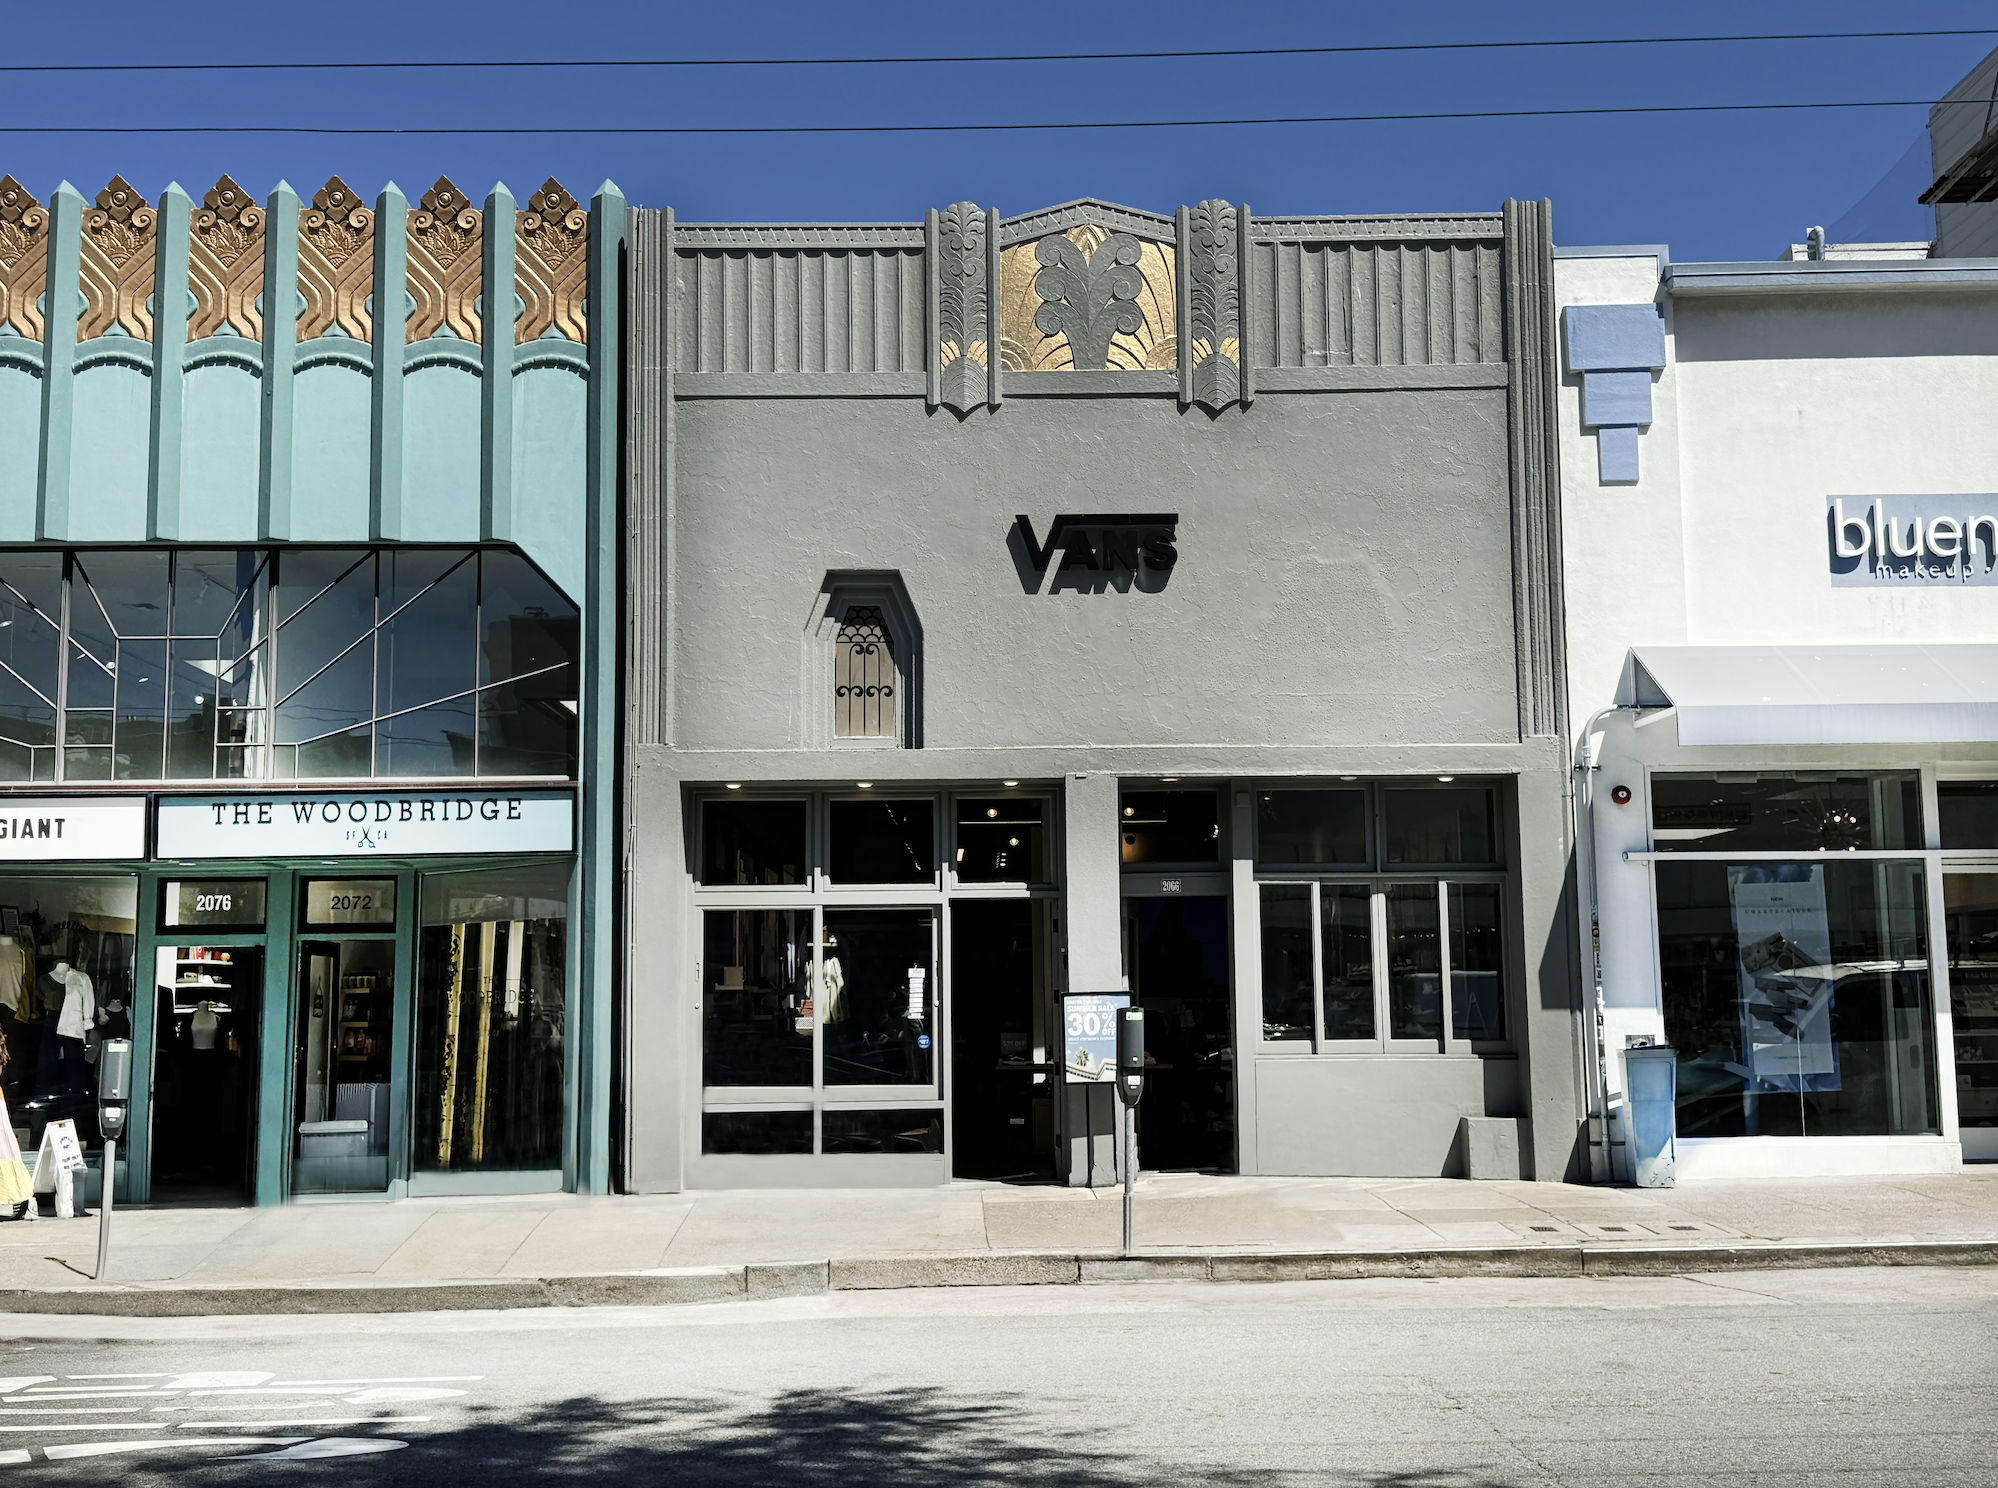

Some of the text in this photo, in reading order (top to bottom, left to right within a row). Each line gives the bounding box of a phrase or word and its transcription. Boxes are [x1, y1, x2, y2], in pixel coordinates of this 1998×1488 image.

[1014, 513, 1179, 572] VANS
[1876, 563, 1975, 582] makeup
[212, 797, 523, 825] THE WOODBRIDGE
[0, 818, 66, 840] GIANT
[196, 894, 232, 912] 2076
[331, 895, 372, 911] 2072
[1098, 1004, 1115, 1012] SALE
[1102, 1028, 1116, 1036] OFF
